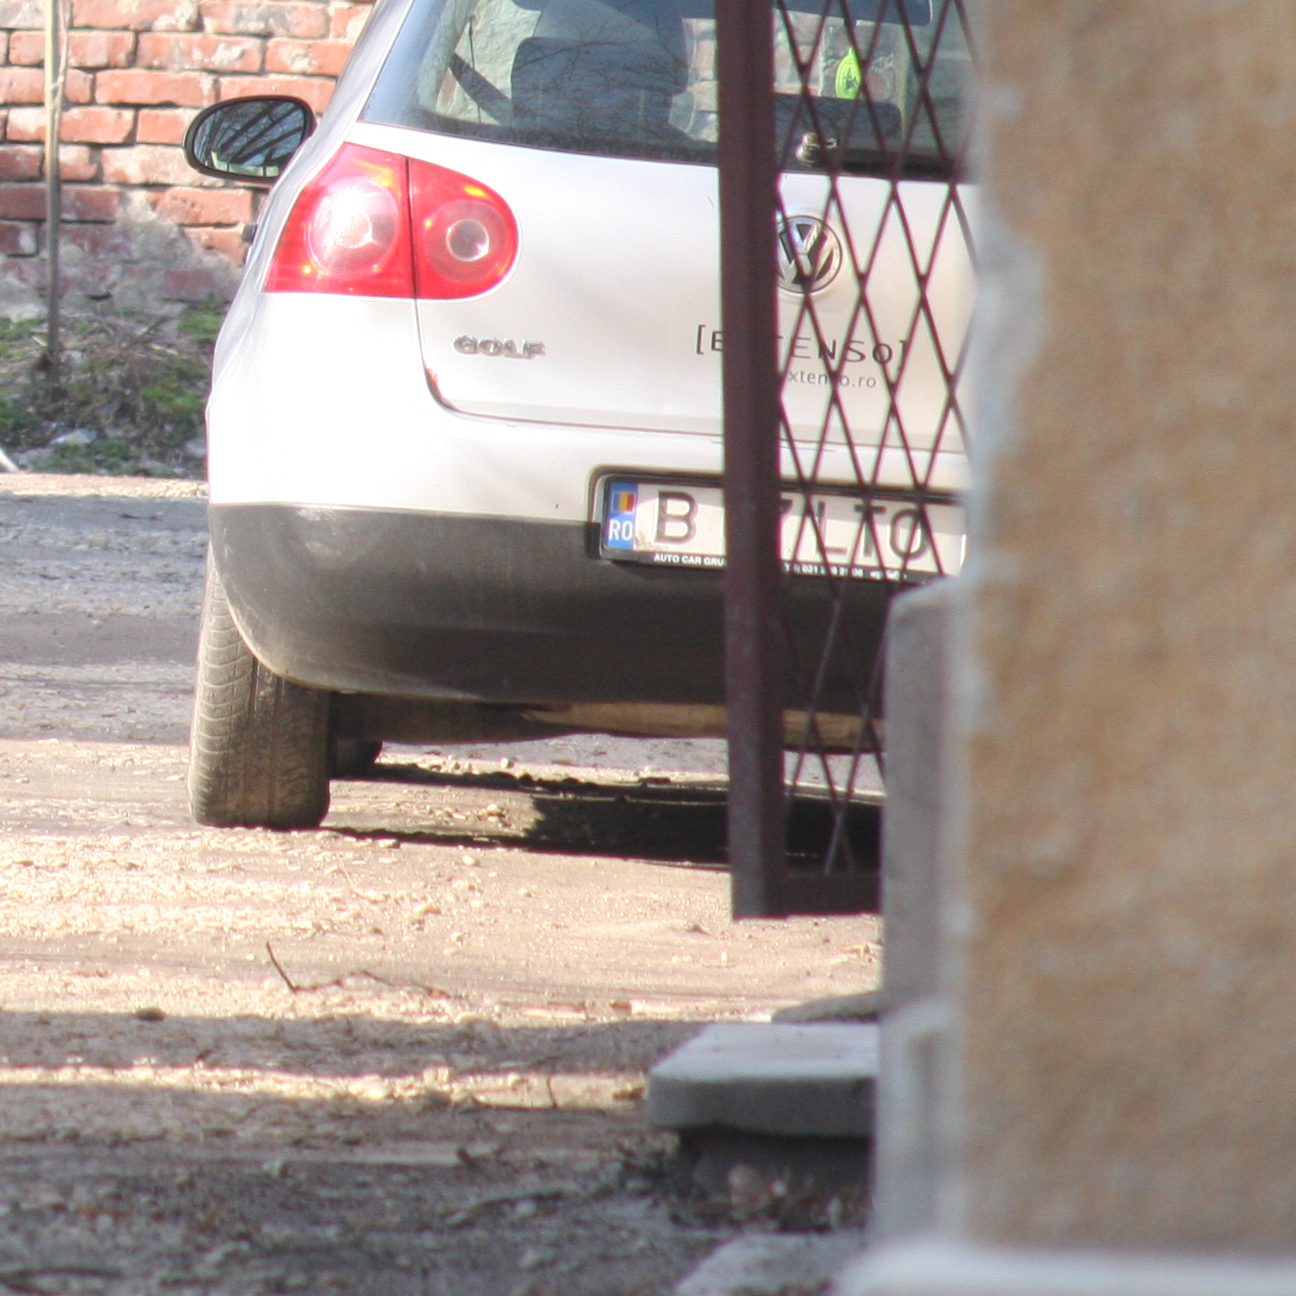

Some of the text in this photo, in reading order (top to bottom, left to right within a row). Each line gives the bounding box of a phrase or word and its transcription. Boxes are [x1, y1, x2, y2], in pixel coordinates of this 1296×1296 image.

[452, 334, 546, 360] GOLF
[655, 491, 697, 543] B
[608, 519, 633, 541] RO
[654, 553, 679, 564] AUTO
[682, 555, 702, 565] CAR
[704, 556, 727, 568] GRU
